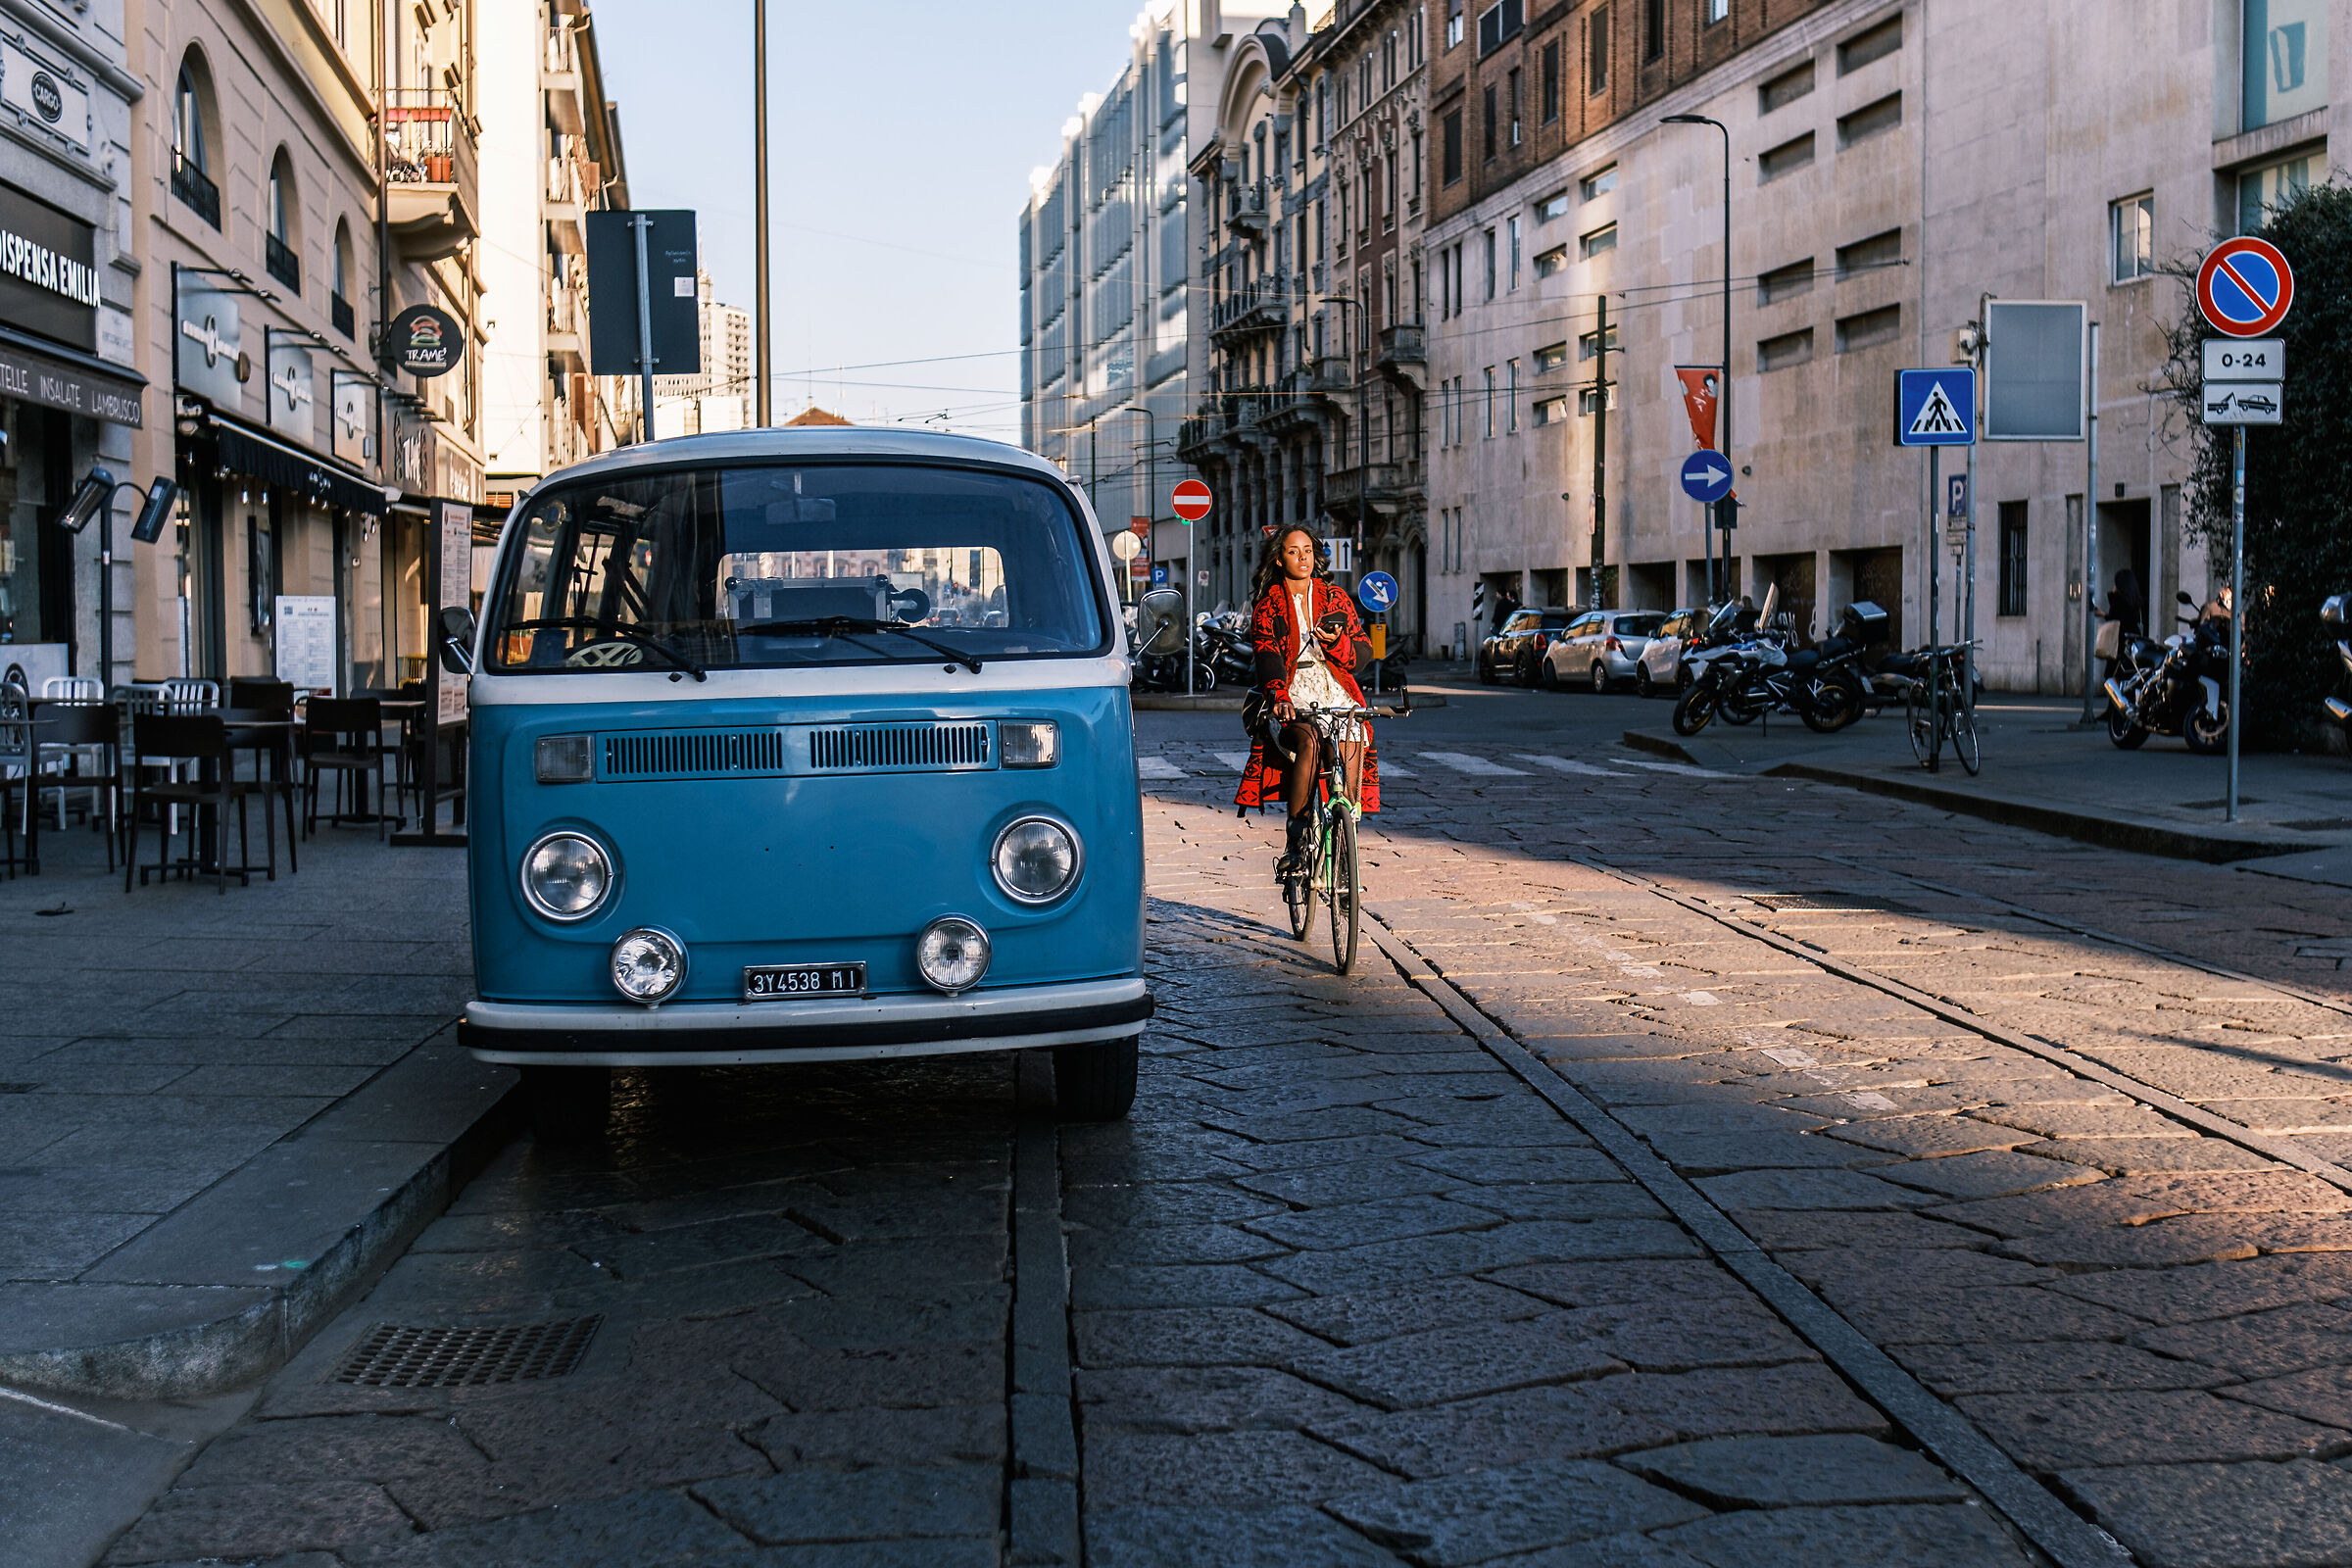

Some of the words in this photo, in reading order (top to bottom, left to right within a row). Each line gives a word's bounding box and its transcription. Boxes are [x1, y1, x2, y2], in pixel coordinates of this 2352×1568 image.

[0, 229, 59, 293] ISPENSA
[60, 255, 101, 309] EMILIA
[2222, 353, 2267, 368] 0-24
[0, 363, 28, 395] TELLE
[40, 374, 81, 409] INSALATE
[92, 390, 140, 424] LAMBRUSCO
[1952, 479, 1964, 511] P
[1155, 569, 1164, 581] P
[754, 971, 820, 993] 3Y4538
